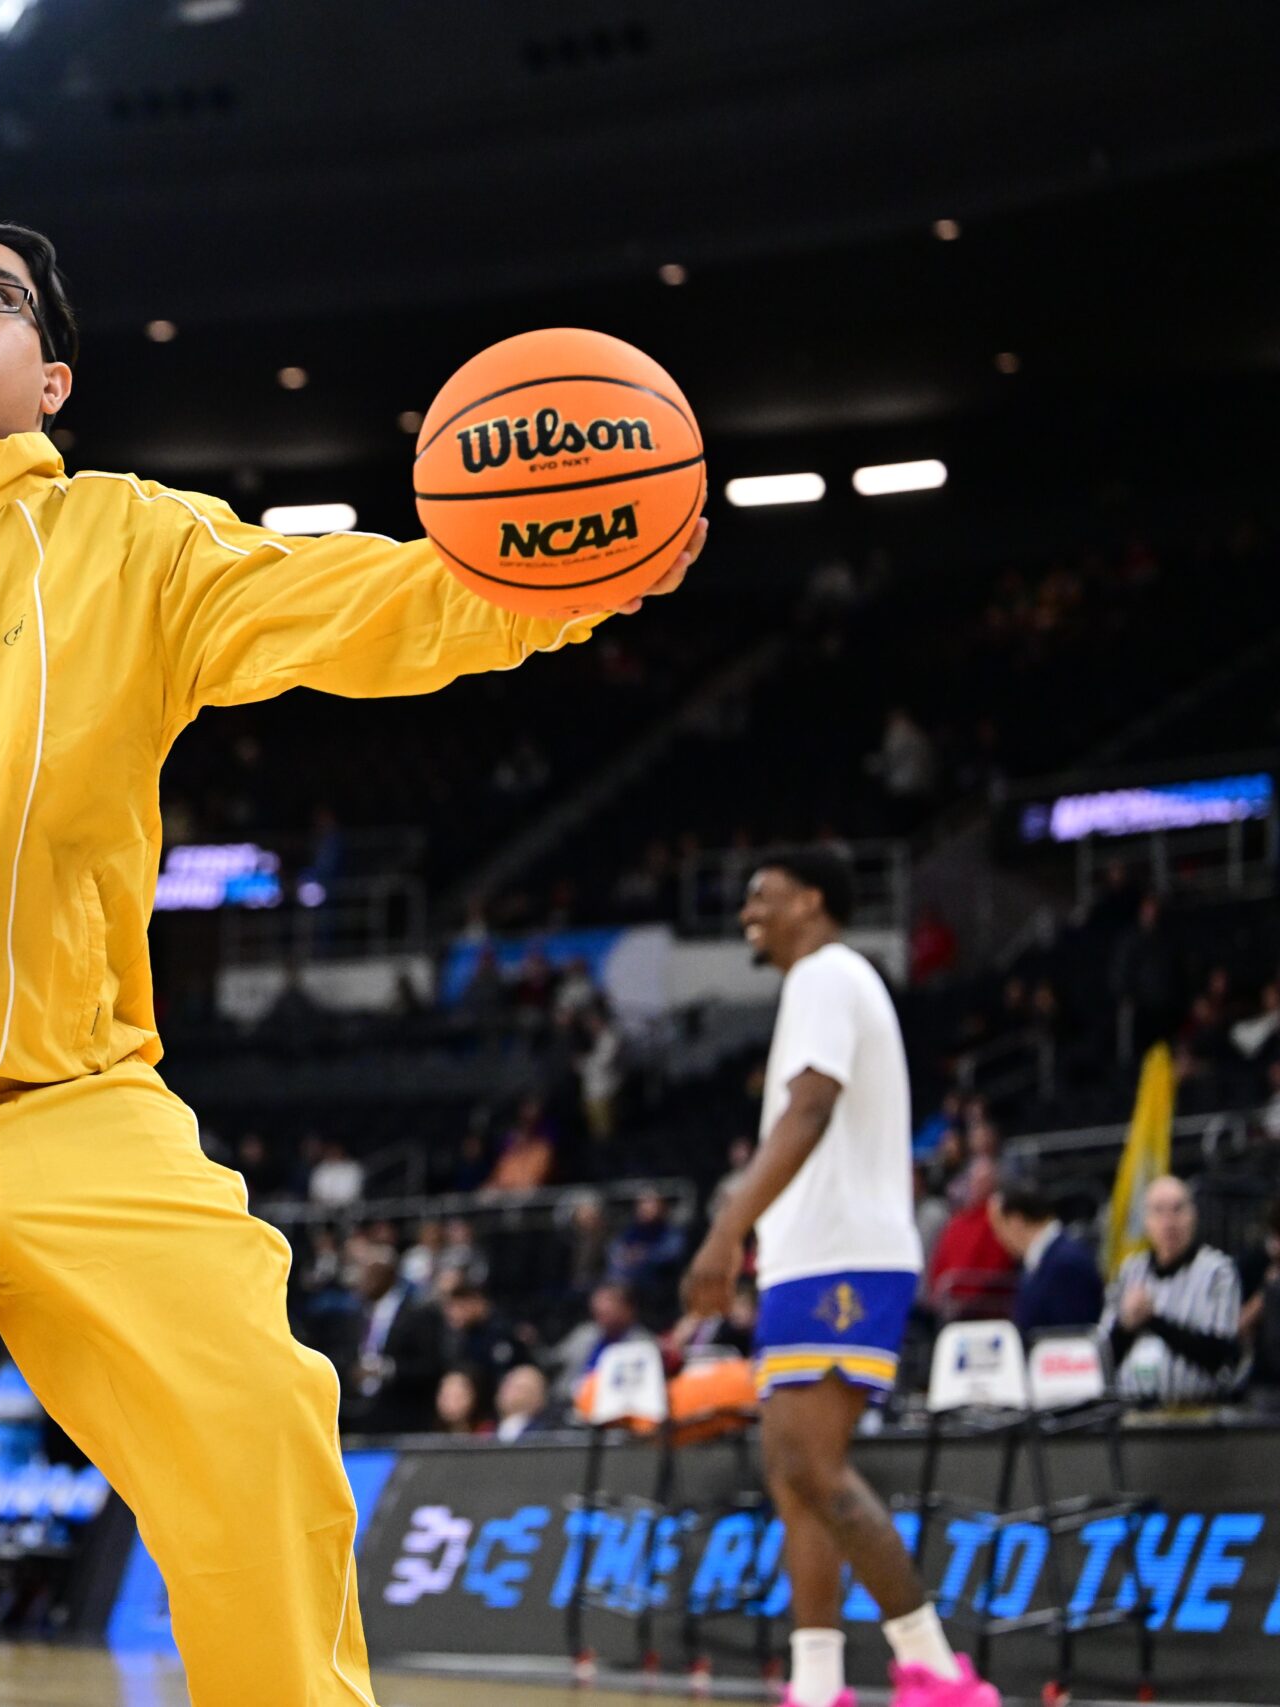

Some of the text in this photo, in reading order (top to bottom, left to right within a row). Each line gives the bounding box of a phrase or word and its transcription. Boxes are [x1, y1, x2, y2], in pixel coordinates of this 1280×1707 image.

[456, 407, 654, 474] Wilson
[529, 456, 591, 472] EVO NXT
[498, 502, 638, 558] NCAA
